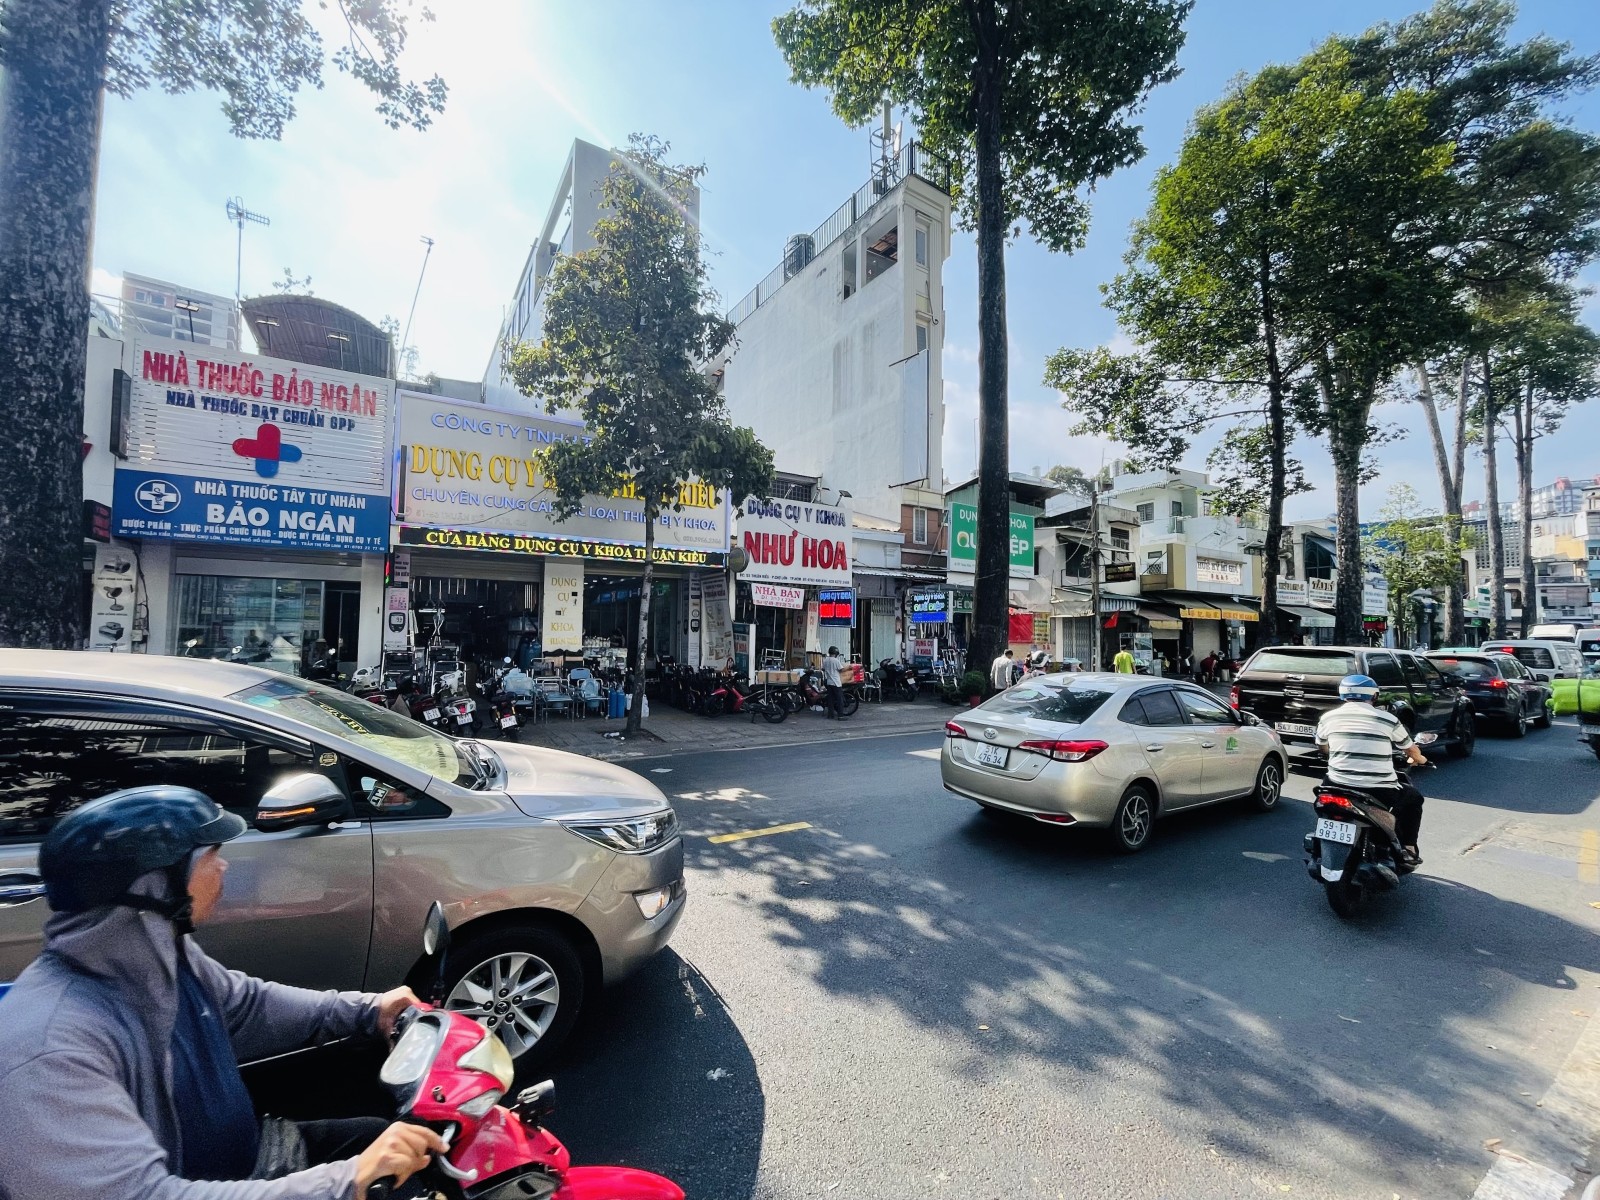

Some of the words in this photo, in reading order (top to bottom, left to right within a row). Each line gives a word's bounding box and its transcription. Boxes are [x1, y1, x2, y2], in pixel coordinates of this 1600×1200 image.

[143, 350, 190, 387] NHÀ
[196, 360, 264, 398] THUỐC
[272, 368, 314, 406] BẢO
[320, 383, 377, 416] NGÂN
[166, 389, 196, 409] NHÀ
[200, 397, 248, 417] THUỐC
[330, 415, 356, 432] GPP
[431, 412, 493, 435] CÔNG
[496, 423, 521, 439] TY
[525, 426, 577, 445] TNH
[410, 444, 482, 483] DỤNG
[489, 455, 521, 491] CỤ
[523, 459, 539, 487] Y
[194, 480, 227, 497] NHÀ
[231, 484, 278, 501] THUỐC
[282, 488, 306, 504] TÂY
[309, 491, 327, 506] TƯ
[330, 494, 366, 510] NHÂN
[412, 487, 482, 506] CHUYÊN
[483, 495, 526, 510] CUNG
[589, 506, 619, 522] LOẠI
[623, 510, 656, 525] THI
[661, 515, 672, 529] BỊ
[674, 516, 682, 528] Y
[684, 518, 717, 530] KHOA
[207, 500, 270, 527] BẢO
[279, 510, 355, 534] NGÂN
[747, 498, 782, 519] DỤNG
[785, 504, 801, 524] CỤ
[804, 507, 813, 522] Y
[816, 509, 846, 527] KHOA
[1009, 517, 1027, 530] HOA
[426, 529, 462, 546] CỬA
[465, 531, 511, 548] HÀNG
[514, 537, 556, 553] DỤNG
[559, 541, 579, 556] CỤ
[581, 543, 592, 554] Y
[594, 545, 632, 559] KHOA
[744, 529, 798, 566] NHƯ
[802, 537, 848, 571] HOA
[956, 530, 977, 550] QU
[1009, 533, 1029, 557] ỆP
[755, 585, 777, 596] NHÀ
[780, 587, 801, 599] BÁN
[561, 607, 567, 616] Y
[550, 622, 574, 632] KHOA
[985, 745, 1000, 756] 51K
[1319, 829, 1352, 843] 983.85
